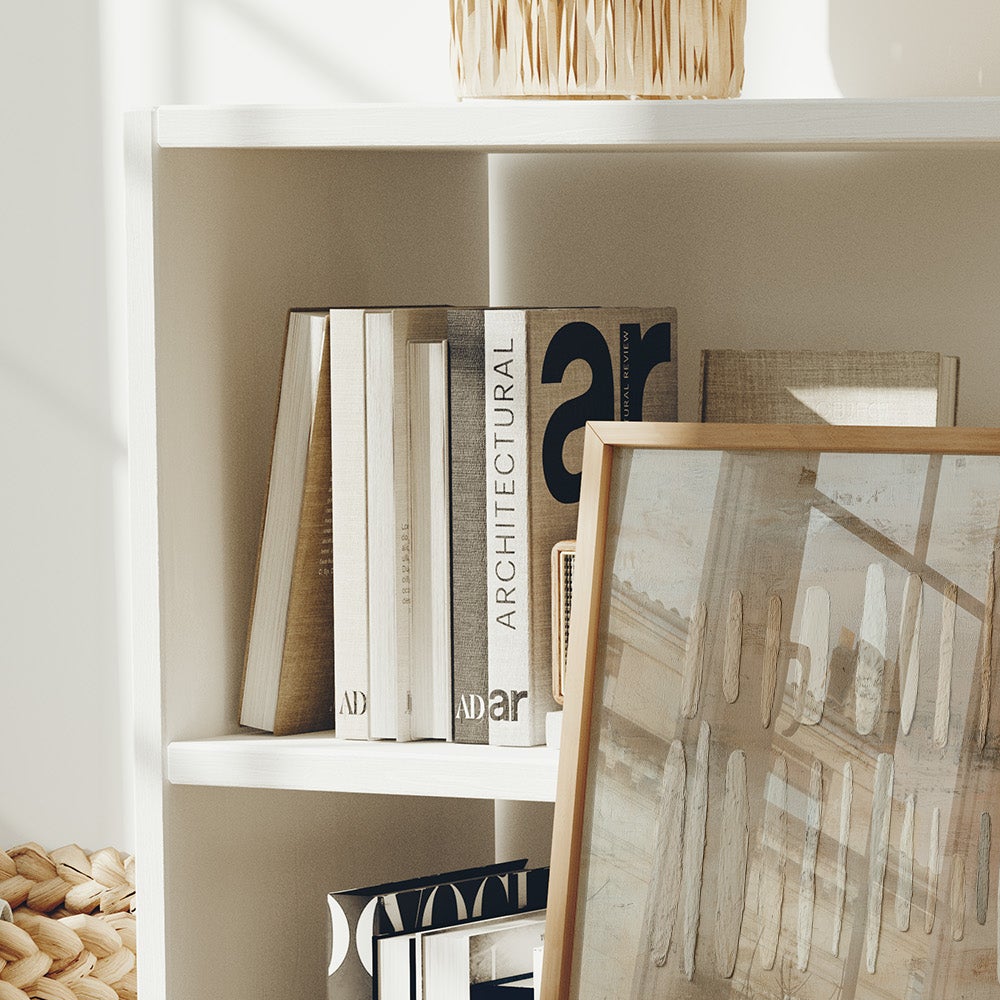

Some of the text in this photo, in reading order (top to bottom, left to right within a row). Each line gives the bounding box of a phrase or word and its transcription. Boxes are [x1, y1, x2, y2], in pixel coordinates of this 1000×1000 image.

[541, 322, 671, 505] ar
[493, 338, 516, 630] ARCHITECTURAL
[339, 690, 367, 715] AD
[455, 693, 486, 720] AD
[489, 688, 528, 722] ar
